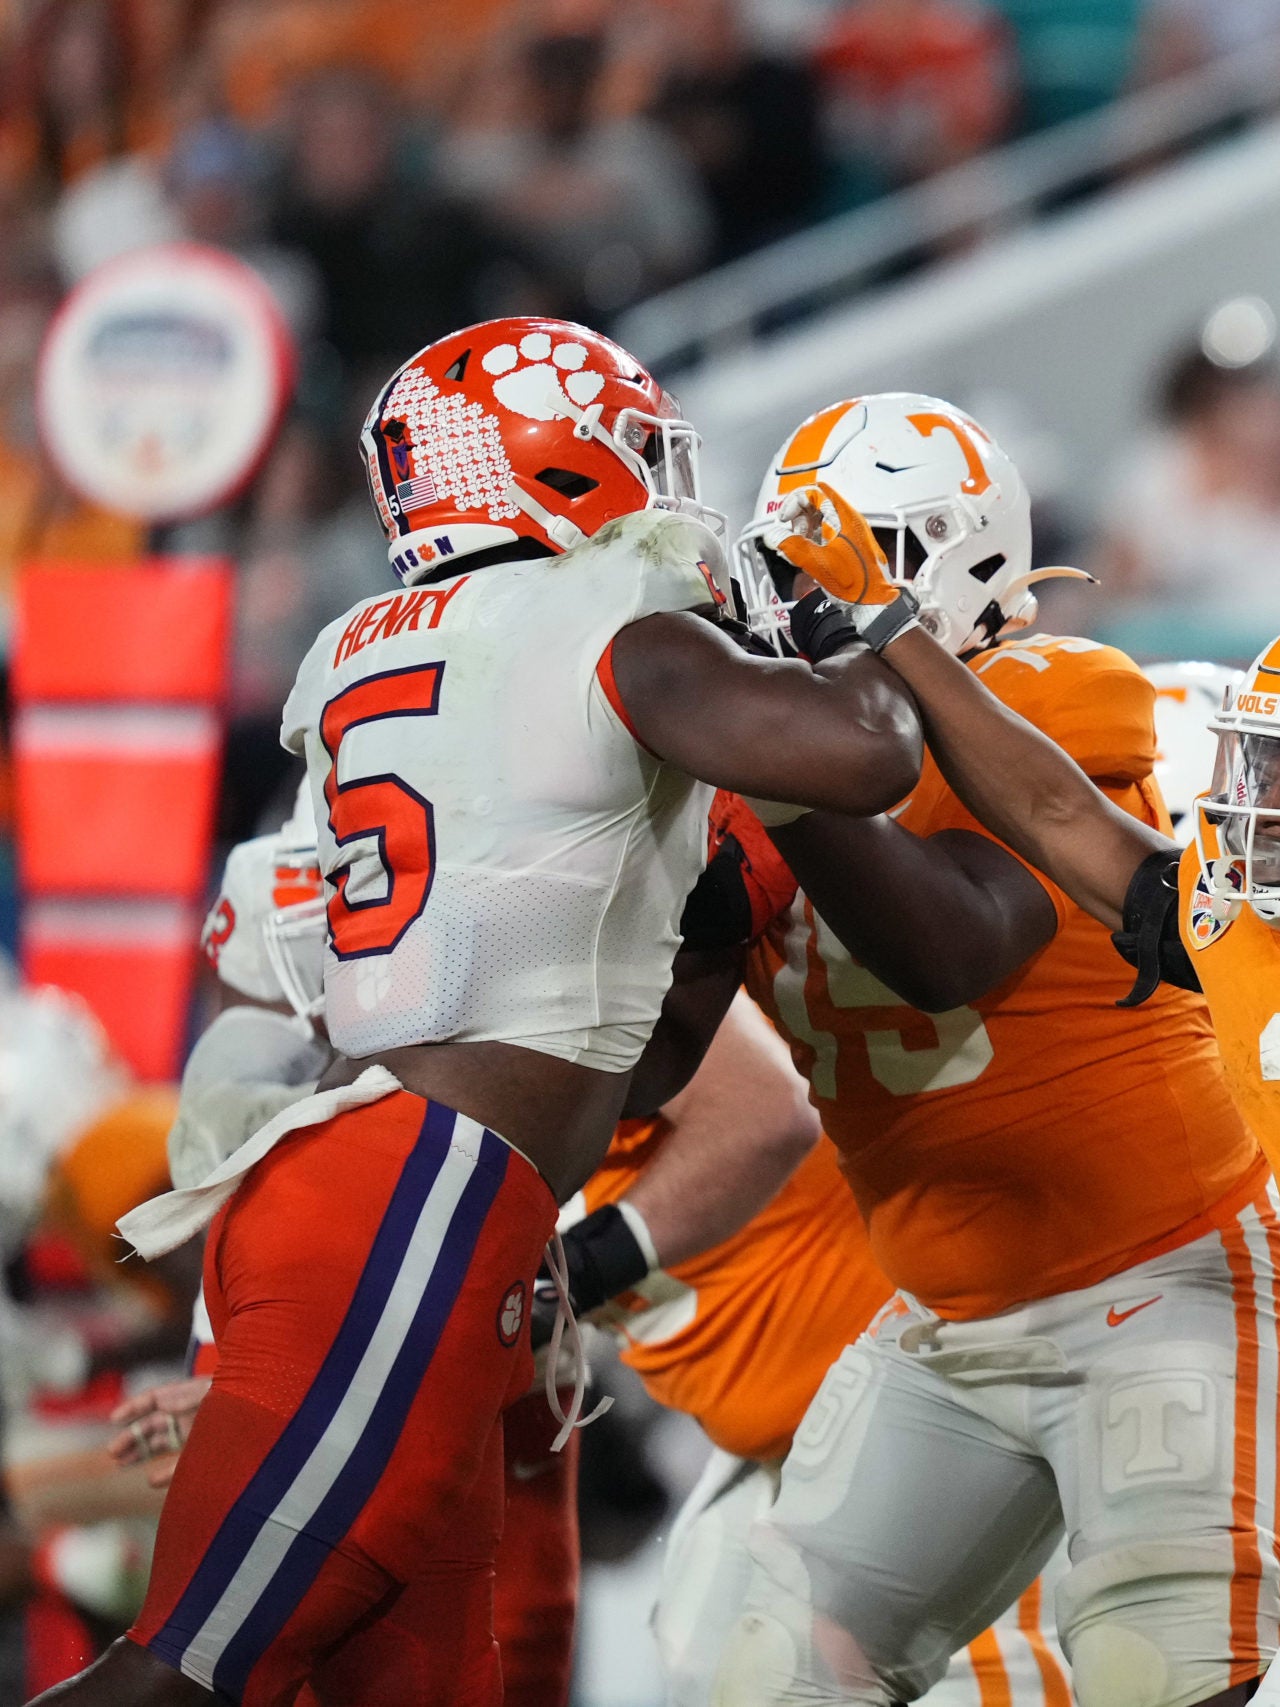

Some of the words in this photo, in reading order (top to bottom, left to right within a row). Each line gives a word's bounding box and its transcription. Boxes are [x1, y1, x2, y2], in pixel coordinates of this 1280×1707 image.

[390, 495, 400, 517] 5
[333, 575, 472, 670] HENRY
[1237, 694, 1277, 715] VOLS
[319, 660, 447, 963] 5
